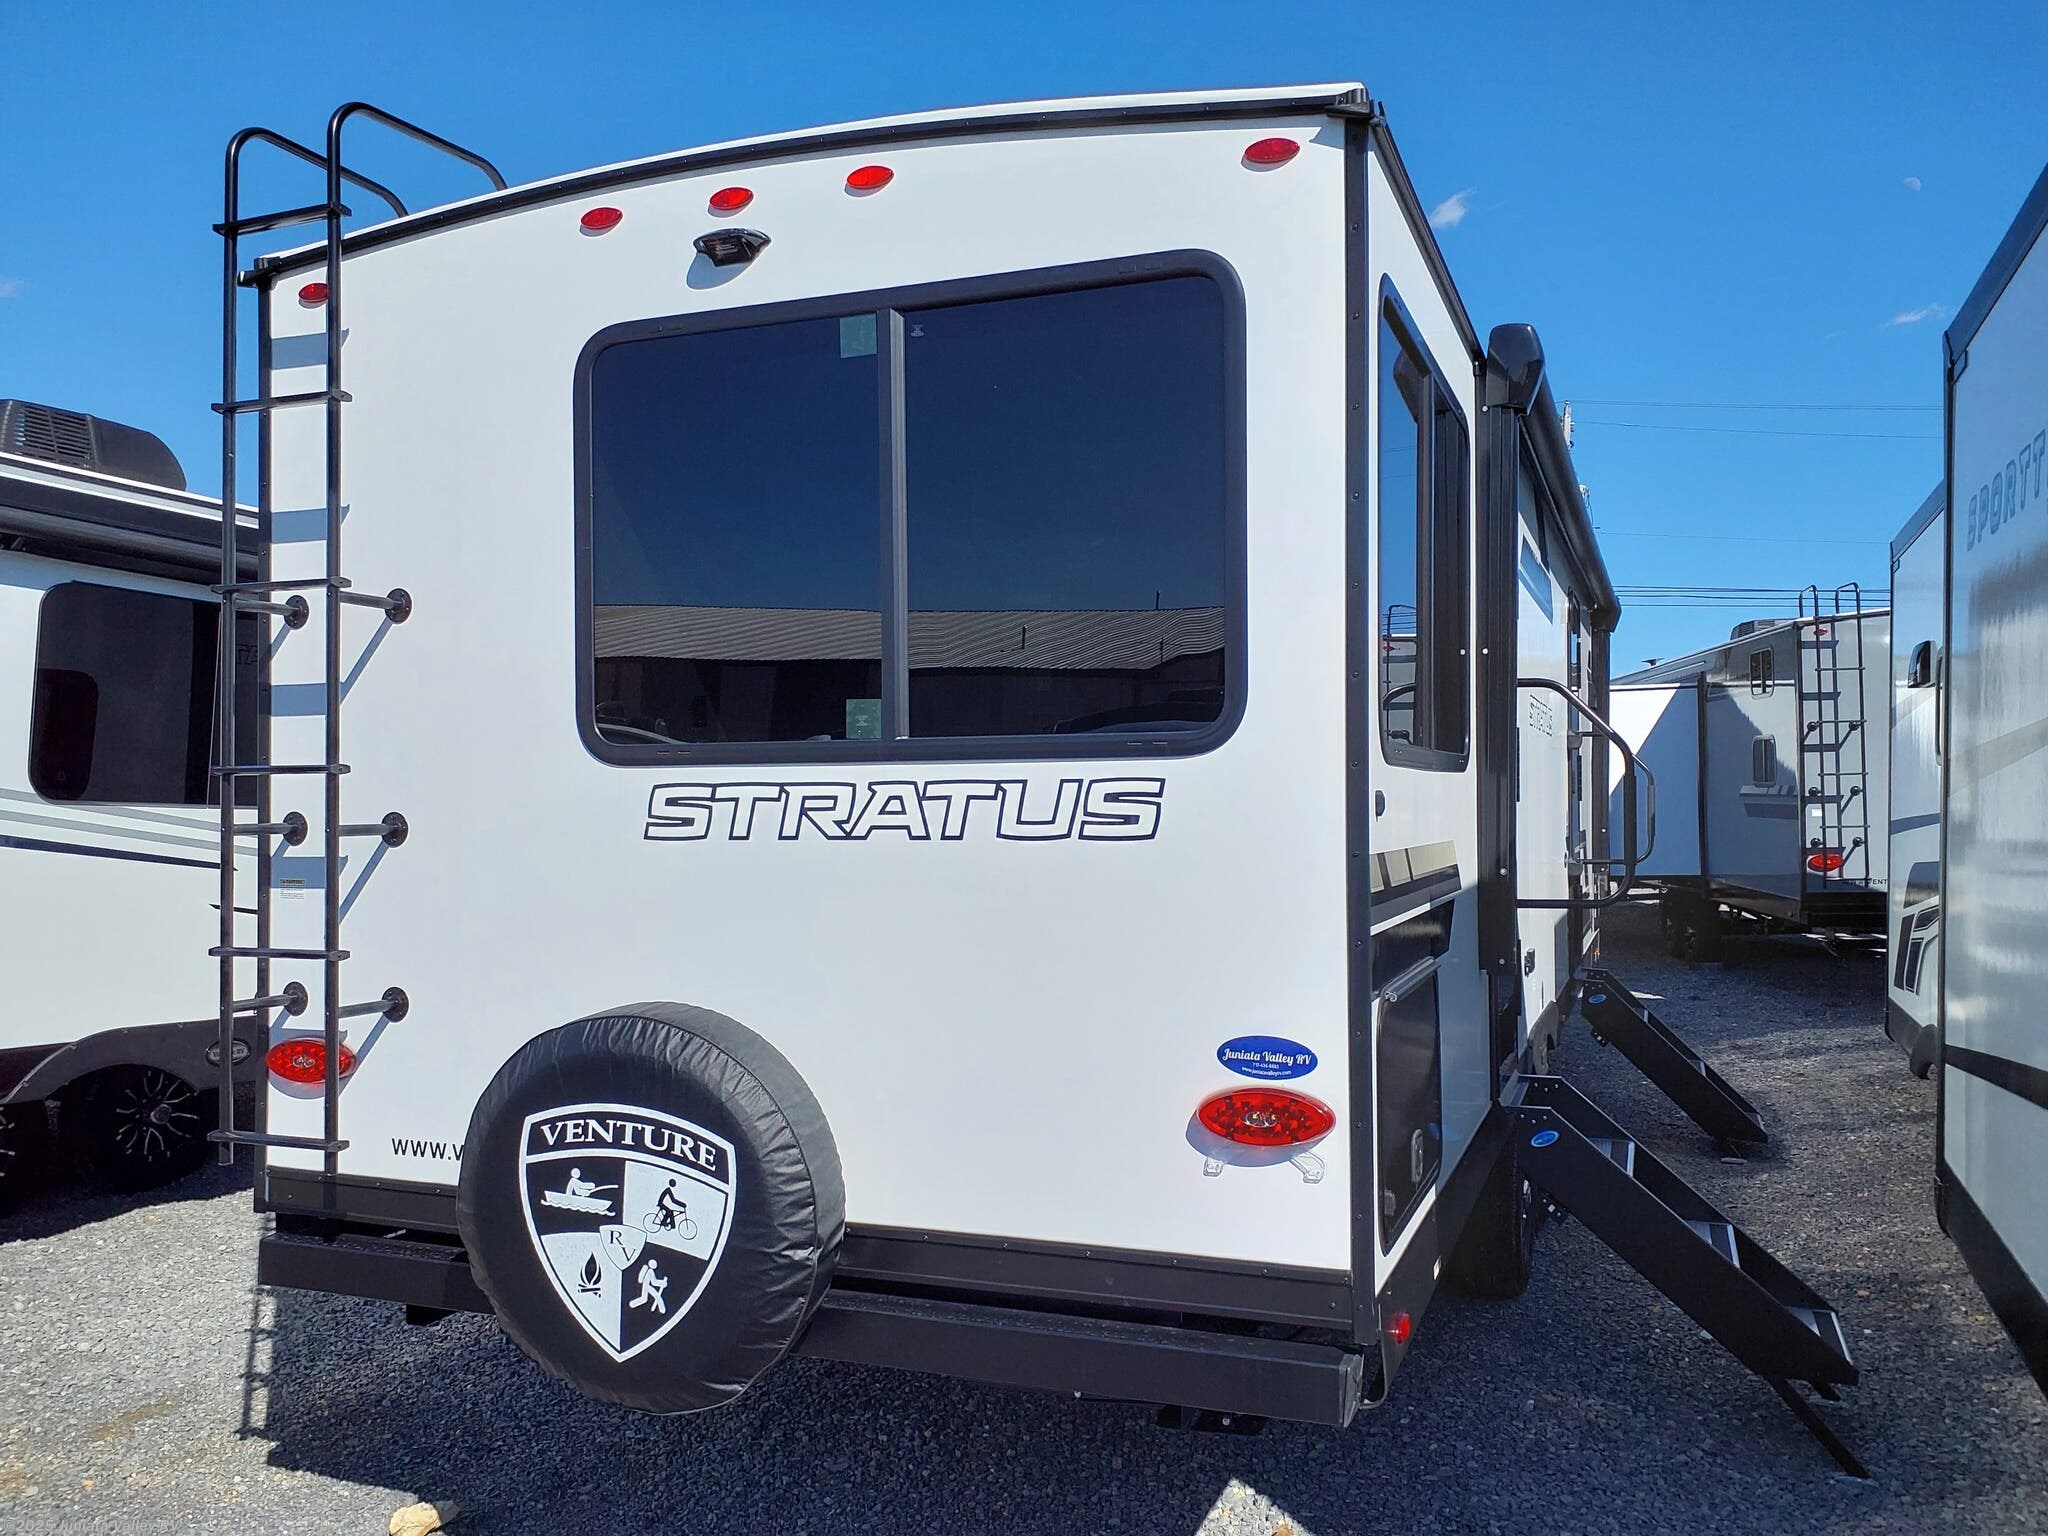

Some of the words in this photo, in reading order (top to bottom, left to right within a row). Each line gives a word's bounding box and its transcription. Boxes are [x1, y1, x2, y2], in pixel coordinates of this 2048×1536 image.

[1966, 428, 2048, 552] SPORTT
[643, 777, 1166, 841] STRATUS
[1222, 1048, 1260, 1061] Juniata
[1262, 1051, 1294, 1067] Valley
[1295, 1053, 1312, 1065] RV
[540, 1119, 717, 1172] VENTURE
